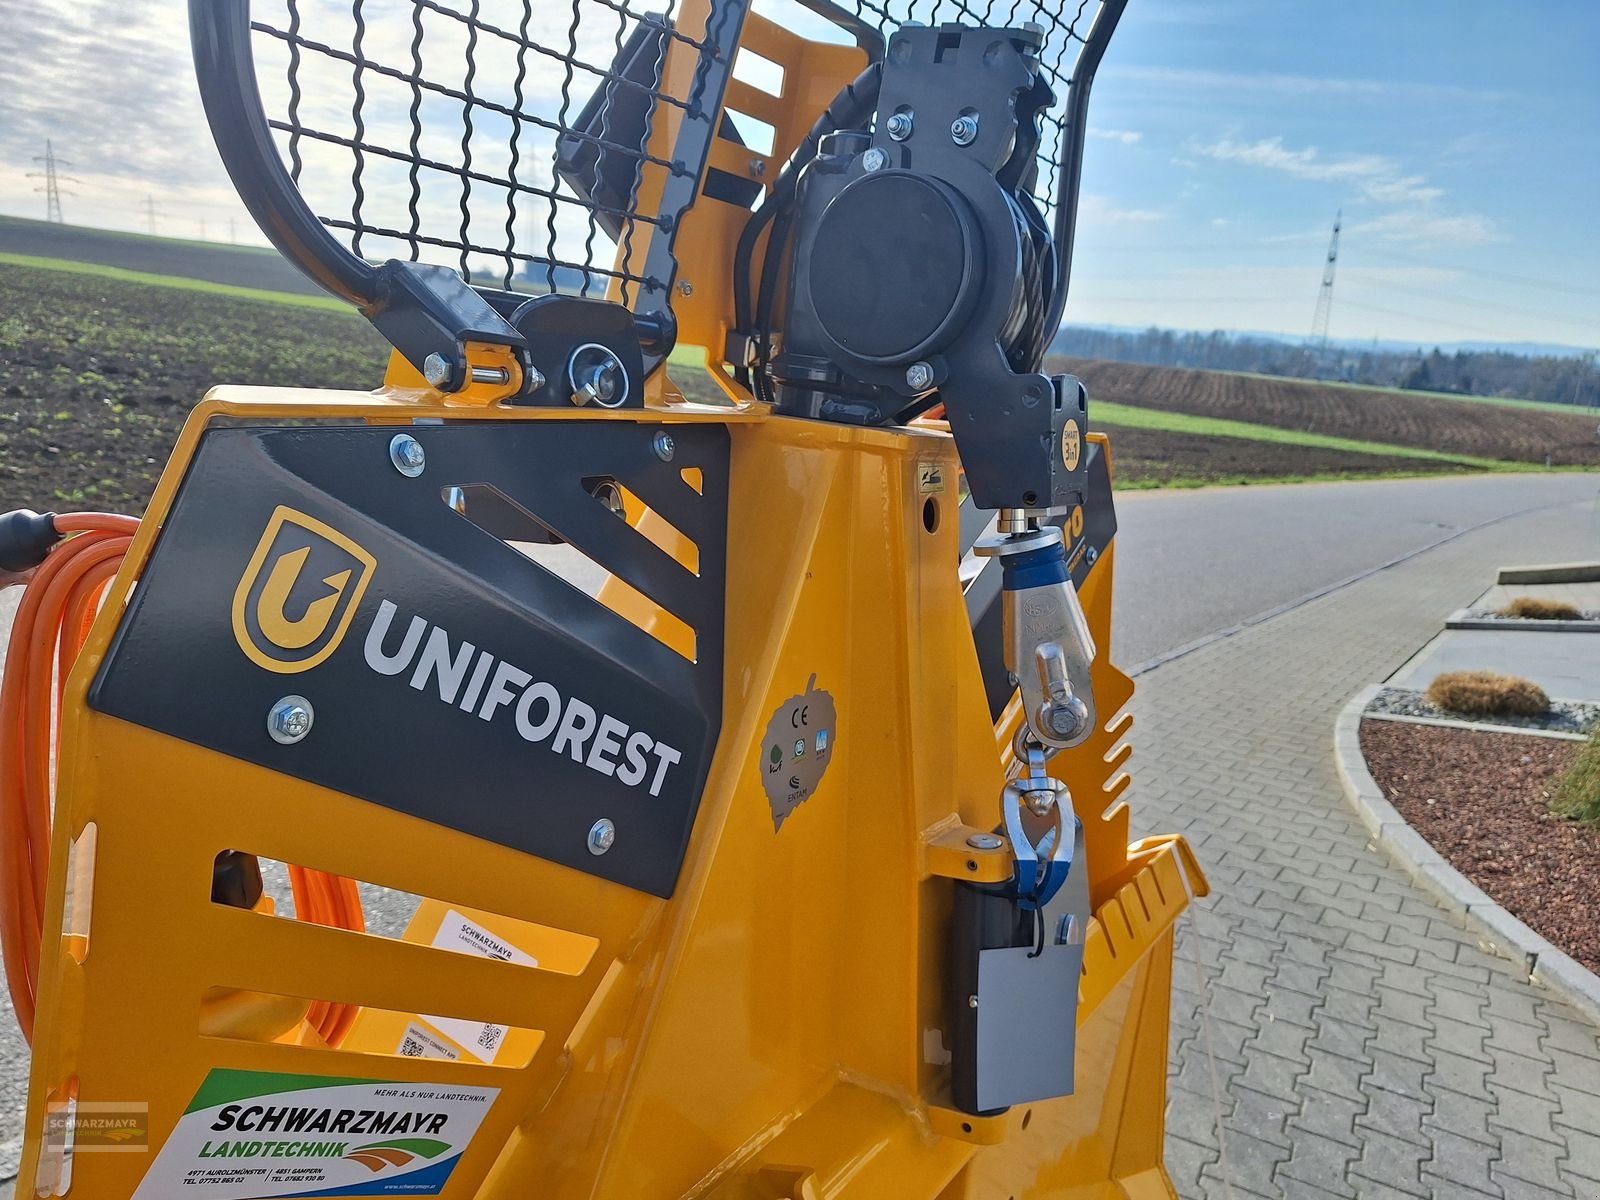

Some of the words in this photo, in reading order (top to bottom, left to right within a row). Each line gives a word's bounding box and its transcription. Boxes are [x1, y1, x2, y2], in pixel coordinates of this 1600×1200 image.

[364, 599, 682, 797] UNIFOREST
[458, 933, 488, 954] LANDTECHNIK
[461, 924, 513, 959] SCHWARZMAYR
[374, 1088, 399, 1097] MEHR
[399, 1090, 416, 1098] ALS
[417, 1091, 435, 1100] NUR
[435, 1092, 488, 1103] LANDTECHNIK.
[210, 1104, 448, 1135] SCHWARZMAYR
[198, 1140, 349, 1158] LANDTECHNIK
[206, 1168, 267, 1176] AUROLZMÜNSTER
